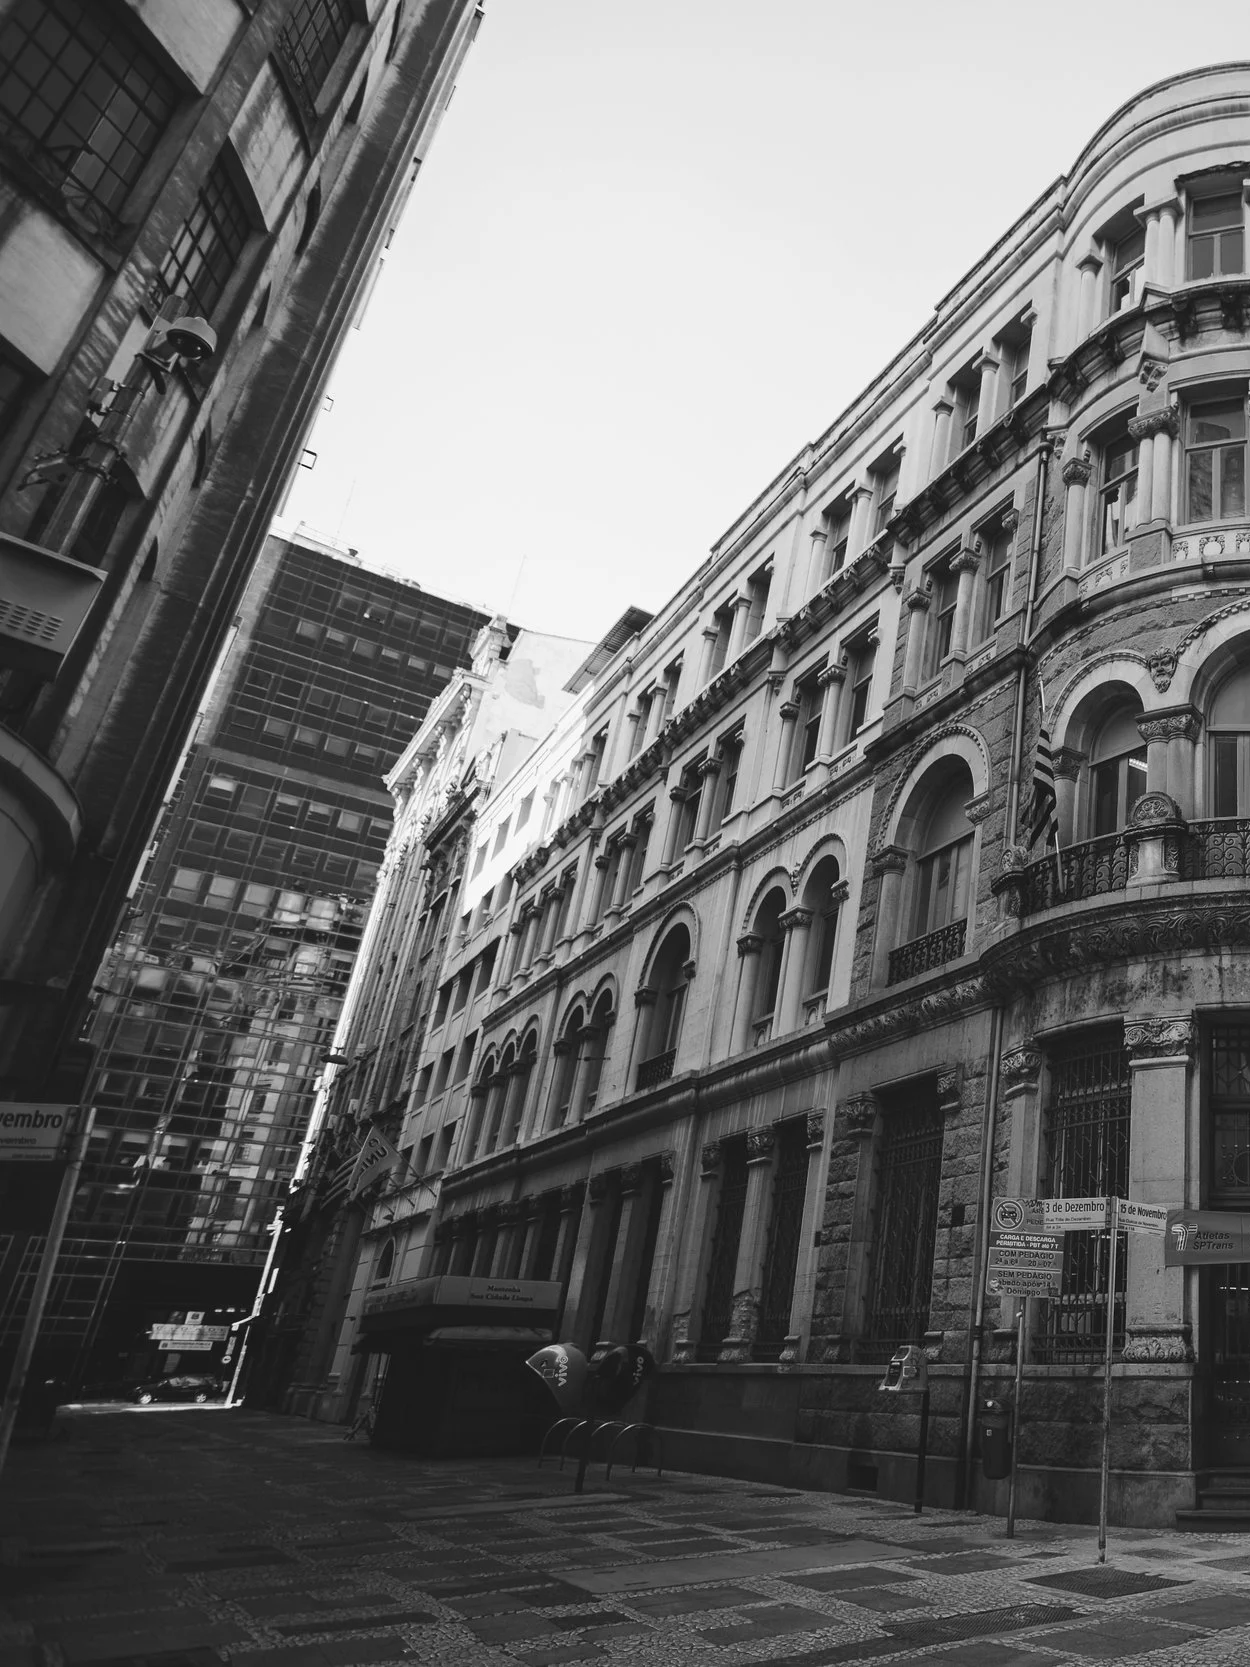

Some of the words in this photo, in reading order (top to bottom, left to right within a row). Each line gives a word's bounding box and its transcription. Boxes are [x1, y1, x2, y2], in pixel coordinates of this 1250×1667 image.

[1045, 1202, 1050, 1213] 3
[1052, 1201, 1063, 1212] de
[1065, 1201, 1105, 1212] Dezembro
[1120, 1203, 1127, 1213] 15
[1128, 1205, 1136, 1215] de
[1137, 1207, 1167, 1220] Novembro
[1025, 1235, 1056, 1243] DESCARGA
[1194, 1230, 1230, 1240] Atletas
[996, 1239, 1026, 1247] PERMITIDA
[1193, 1240, 1234, 1250] SPTrans
[1018, 1250, 1055, 1260] PEDÁGIO
[1016, 1271, 1053, 1280] PEDÁGIO
[1007, 1287, 1041, 1297] Domingo
[554, 1355, 569, 1387] vivo
[632, 1356, 645, 1386] vivo
